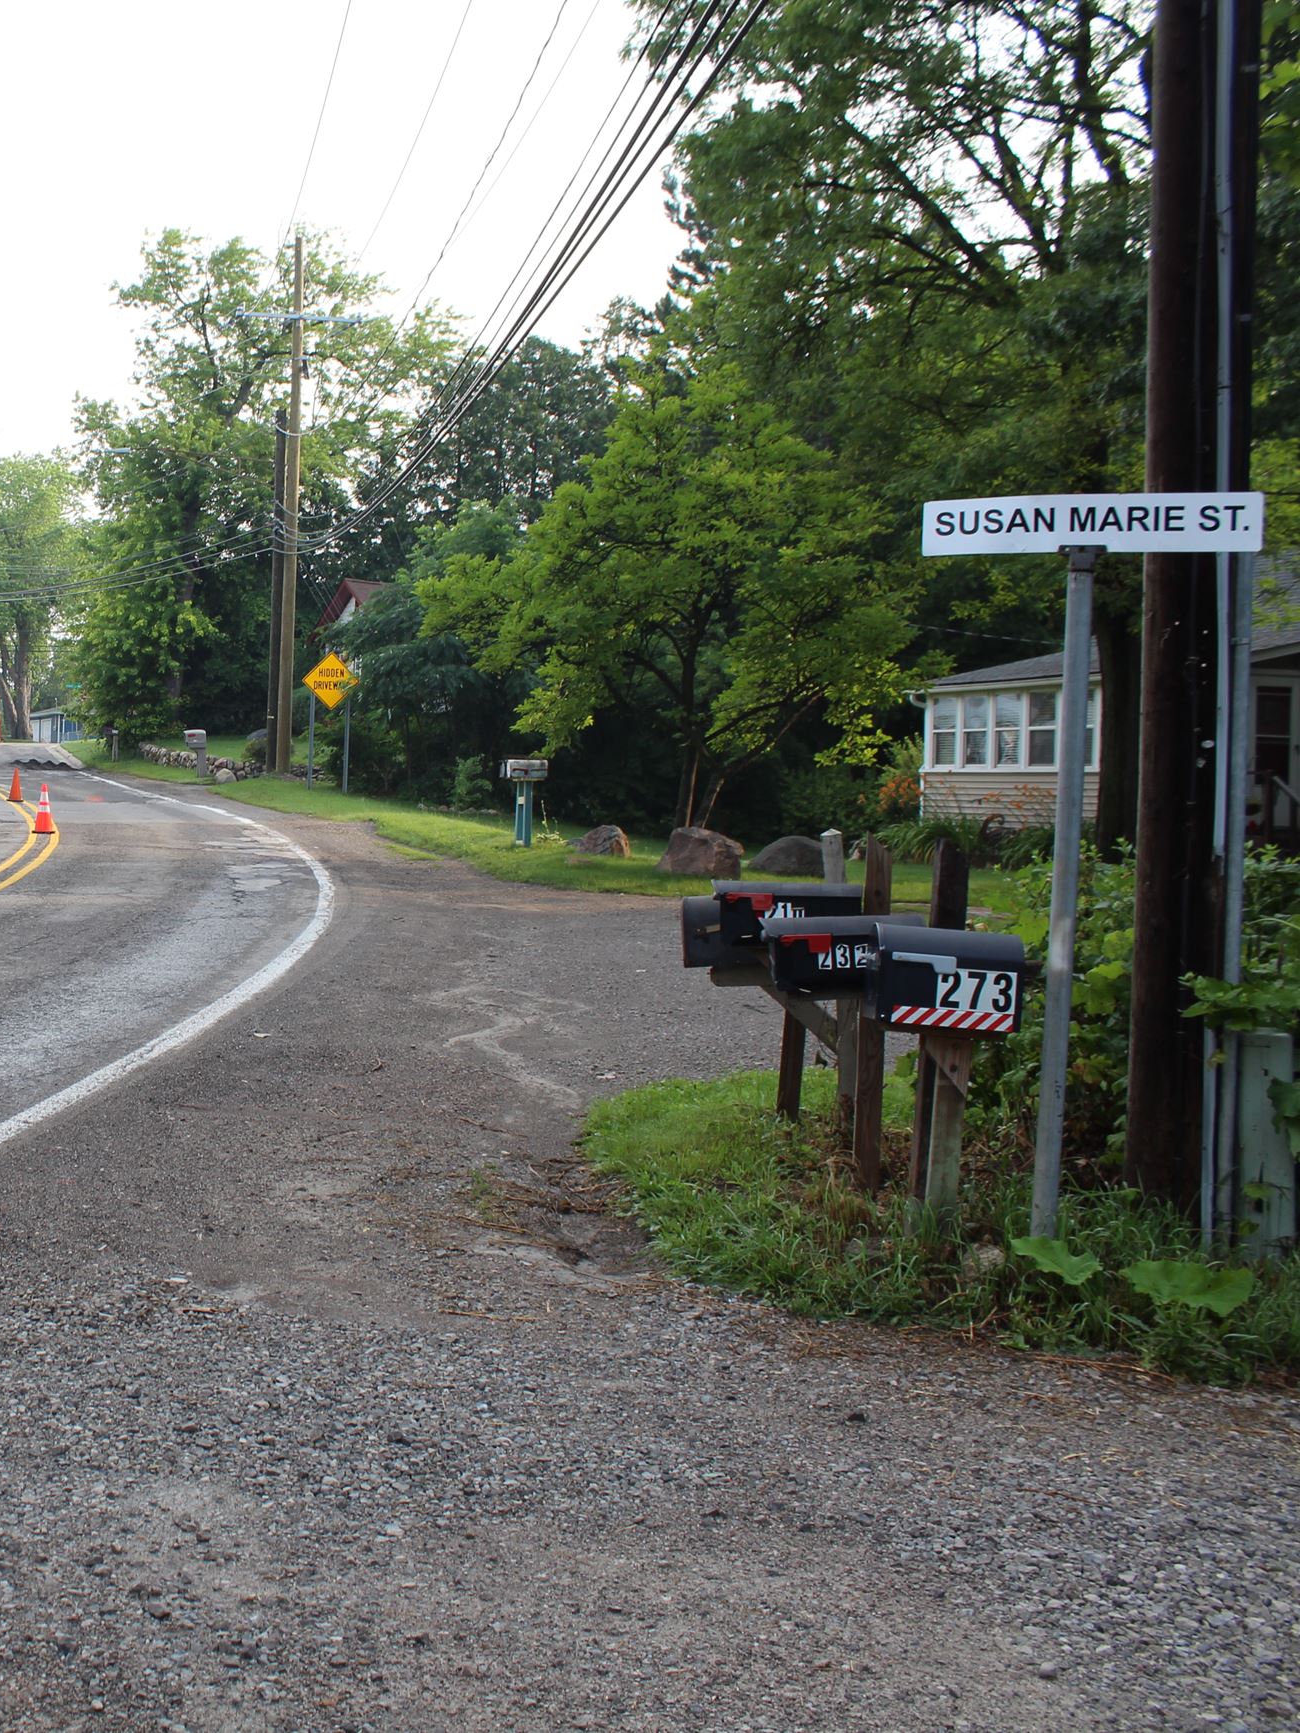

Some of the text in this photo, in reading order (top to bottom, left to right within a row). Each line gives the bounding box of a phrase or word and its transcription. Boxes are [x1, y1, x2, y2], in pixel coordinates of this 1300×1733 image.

[935, 505, 1249, 536] SUSAN MARIE ST.
[319, 668, 344, 678] HIDDEN
[314, 681, 343, 690] DRIVEW
[939, 971, 1013, 1012] 273
